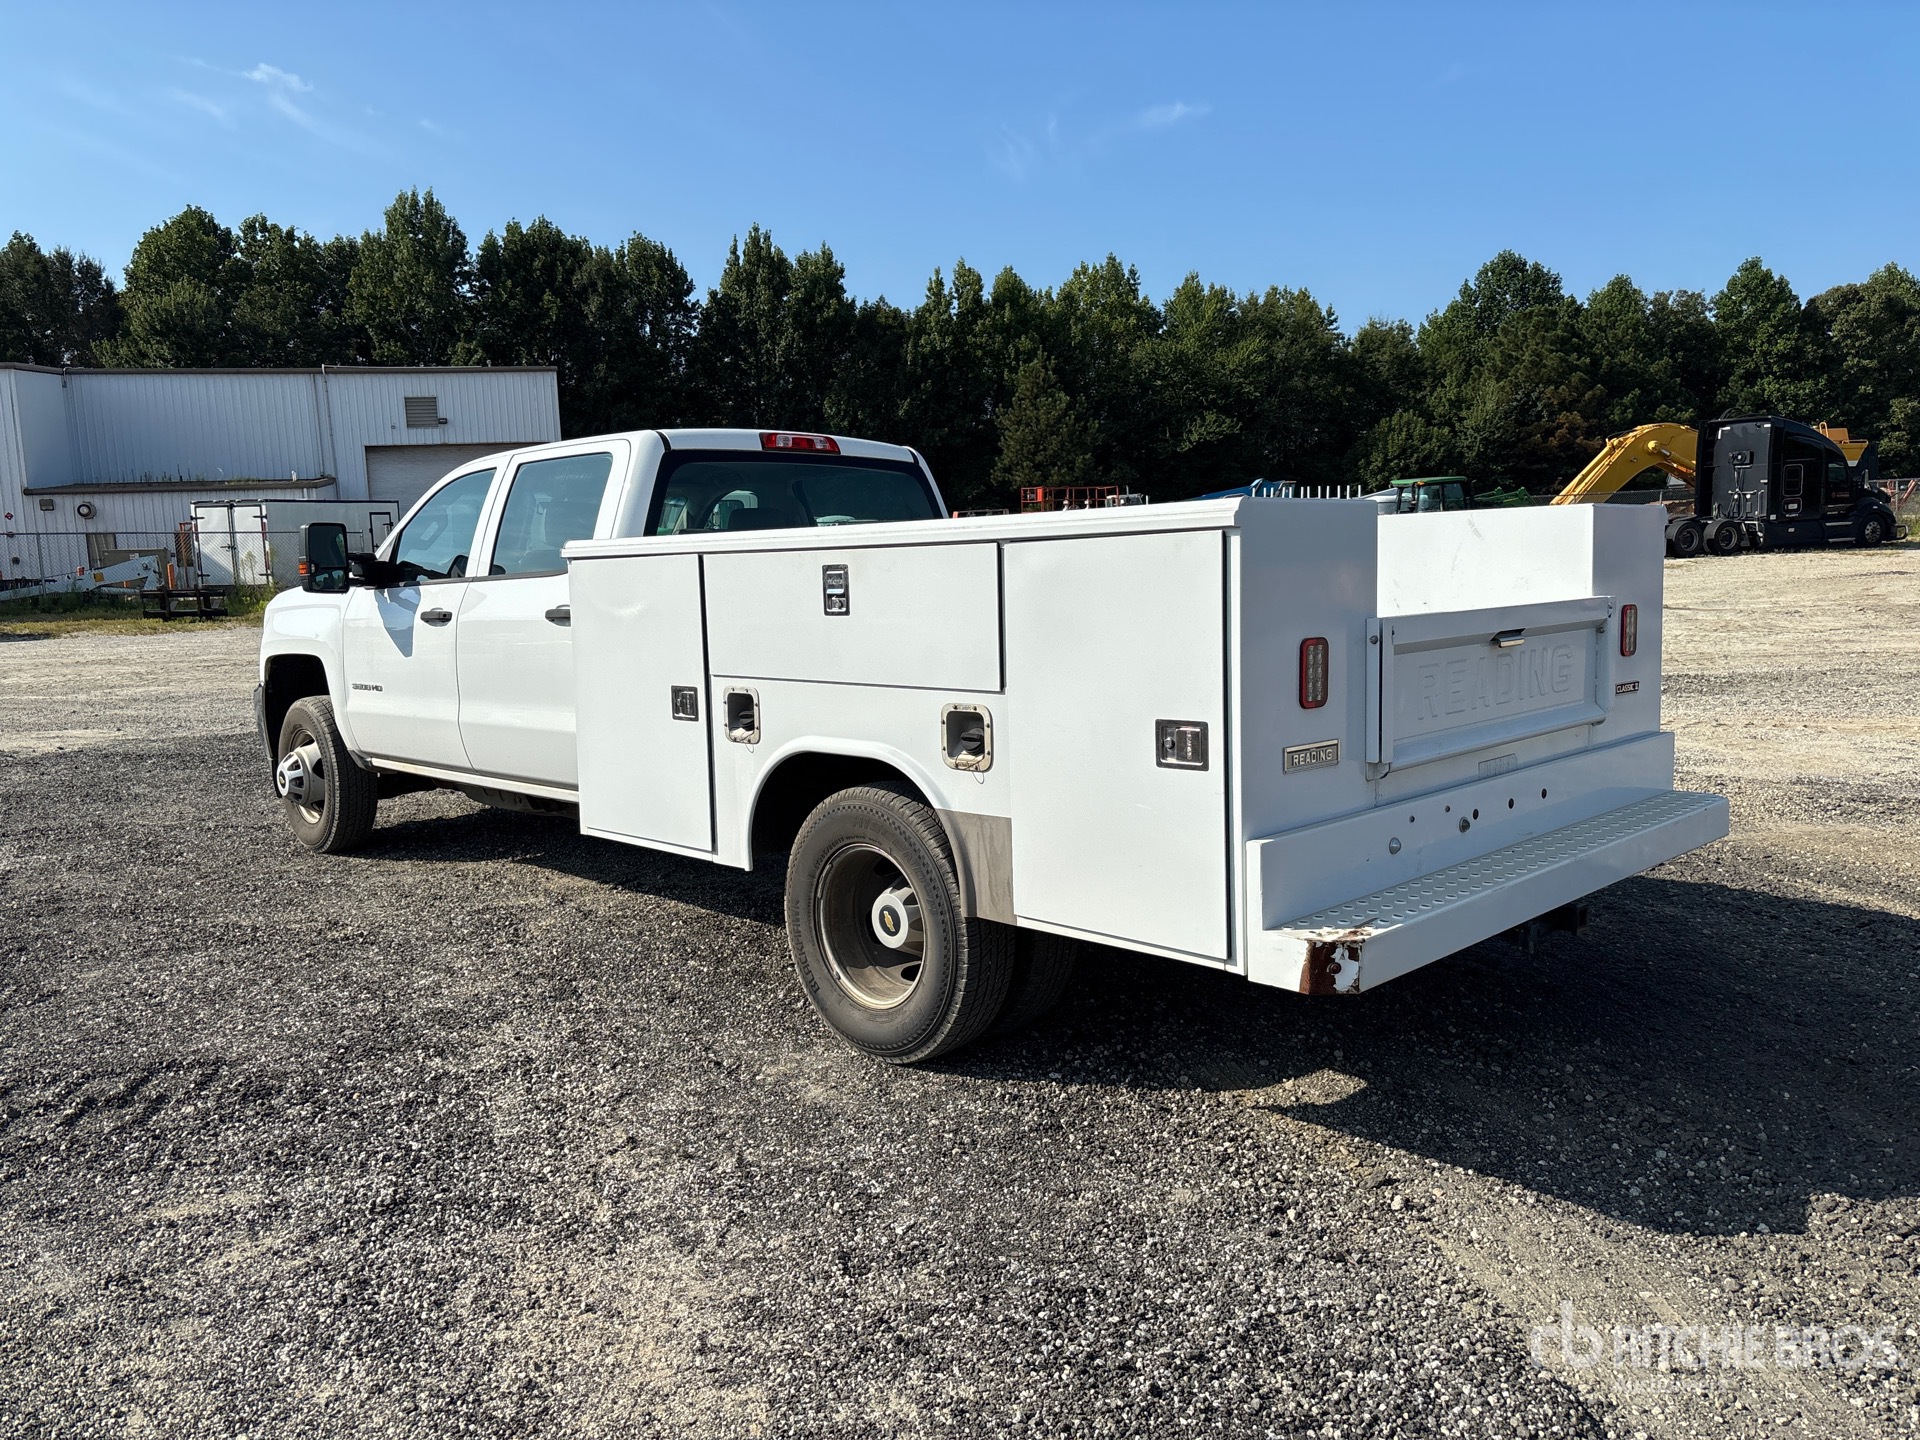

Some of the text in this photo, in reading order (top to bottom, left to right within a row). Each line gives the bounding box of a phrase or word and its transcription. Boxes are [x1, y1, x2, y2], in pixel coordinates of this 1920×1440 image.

[1417, 644, 1574, 721] READING
[1616, 683, 1635, 693] CLASSIC
[1292, 749, 1333, 767] READING
